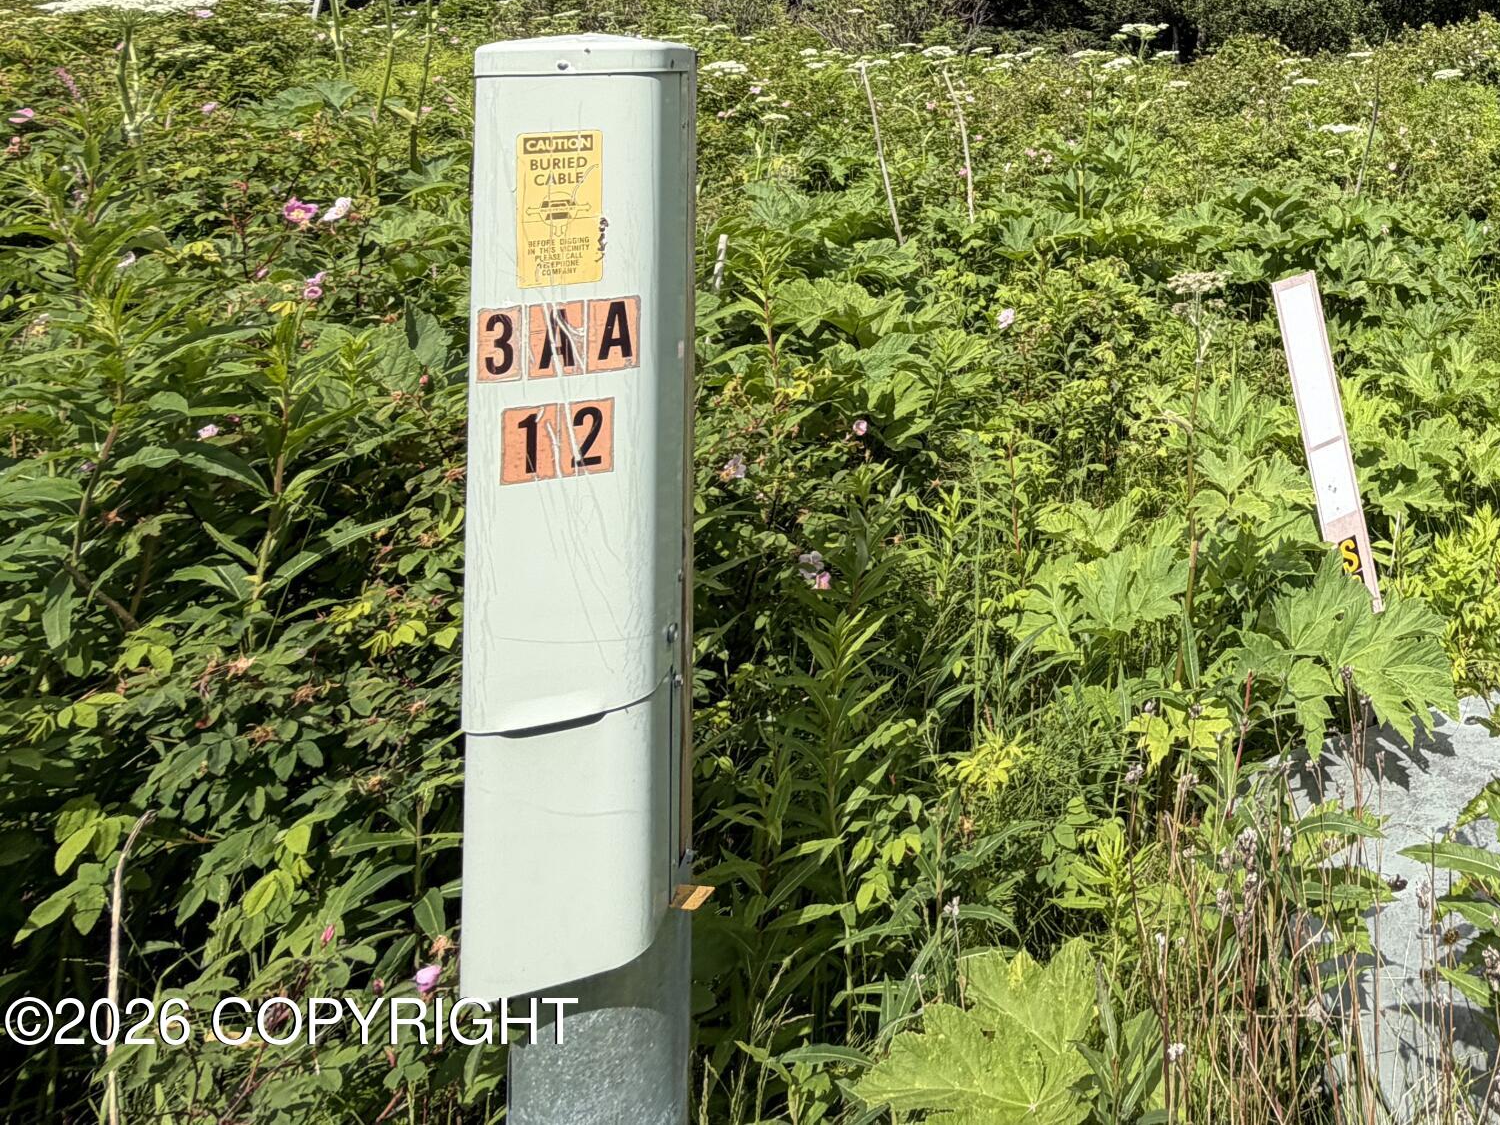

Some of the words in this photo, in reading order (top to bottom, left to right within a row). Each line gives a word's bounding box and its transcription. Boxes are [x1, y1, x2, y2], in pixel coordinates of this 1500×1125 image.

[526, 138, 591, 152] CAUTION
[530, 156, 588, 171] BURIED
[534, 172, 584, 186] CABLE
[527, 239, 556, 248] BEFORE
[559, 236, 590, 246] DIGGING
[527, 248, 537, 256] IN
[560, 244, 590, 253] VICINITY
[534, 253, 561, 262] PLEASE
[566, 252, 583, 260] CALL
[541, 267, 577, 276] COMPANY
[518, 407, 603, 473] 12
